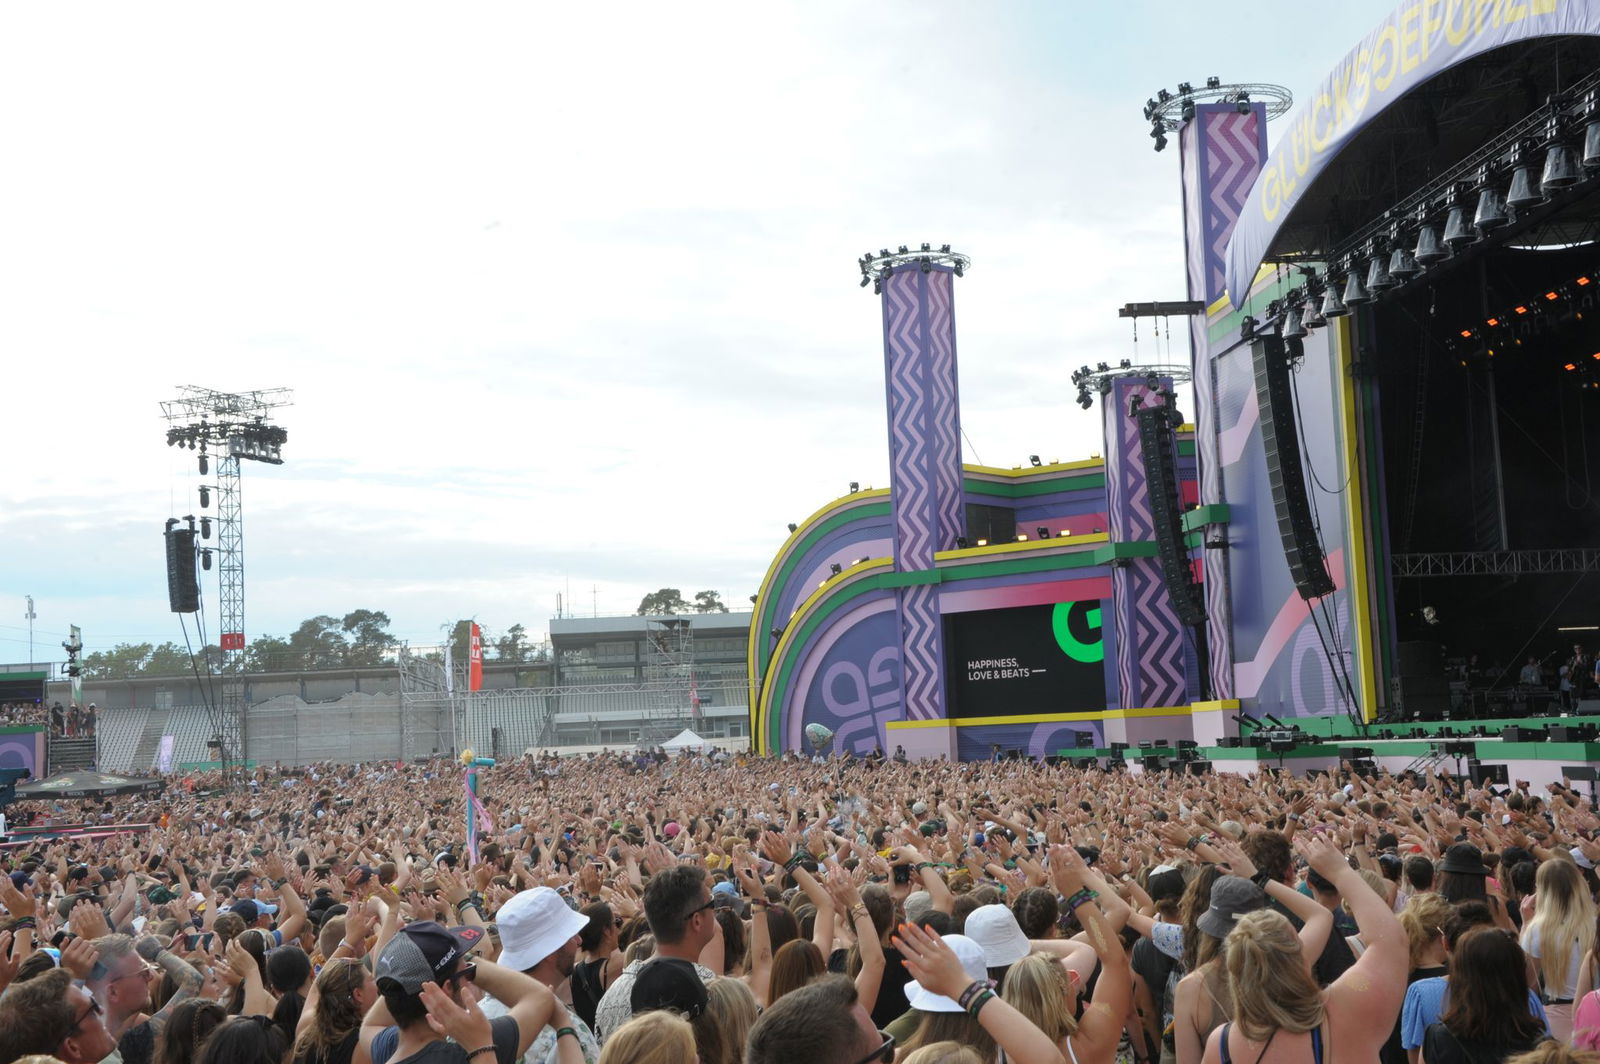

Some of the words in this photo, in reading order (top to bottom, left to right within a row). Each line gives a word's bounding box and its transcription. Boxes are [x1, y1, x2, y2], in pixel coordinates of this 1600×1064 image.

[968, 658, 1019, 669] HAPPINESS,
[968, 670, 992, 680] LOVE
[993, 670, 1000, 679] &
[1001, 668, 1030, 679] BEATS
